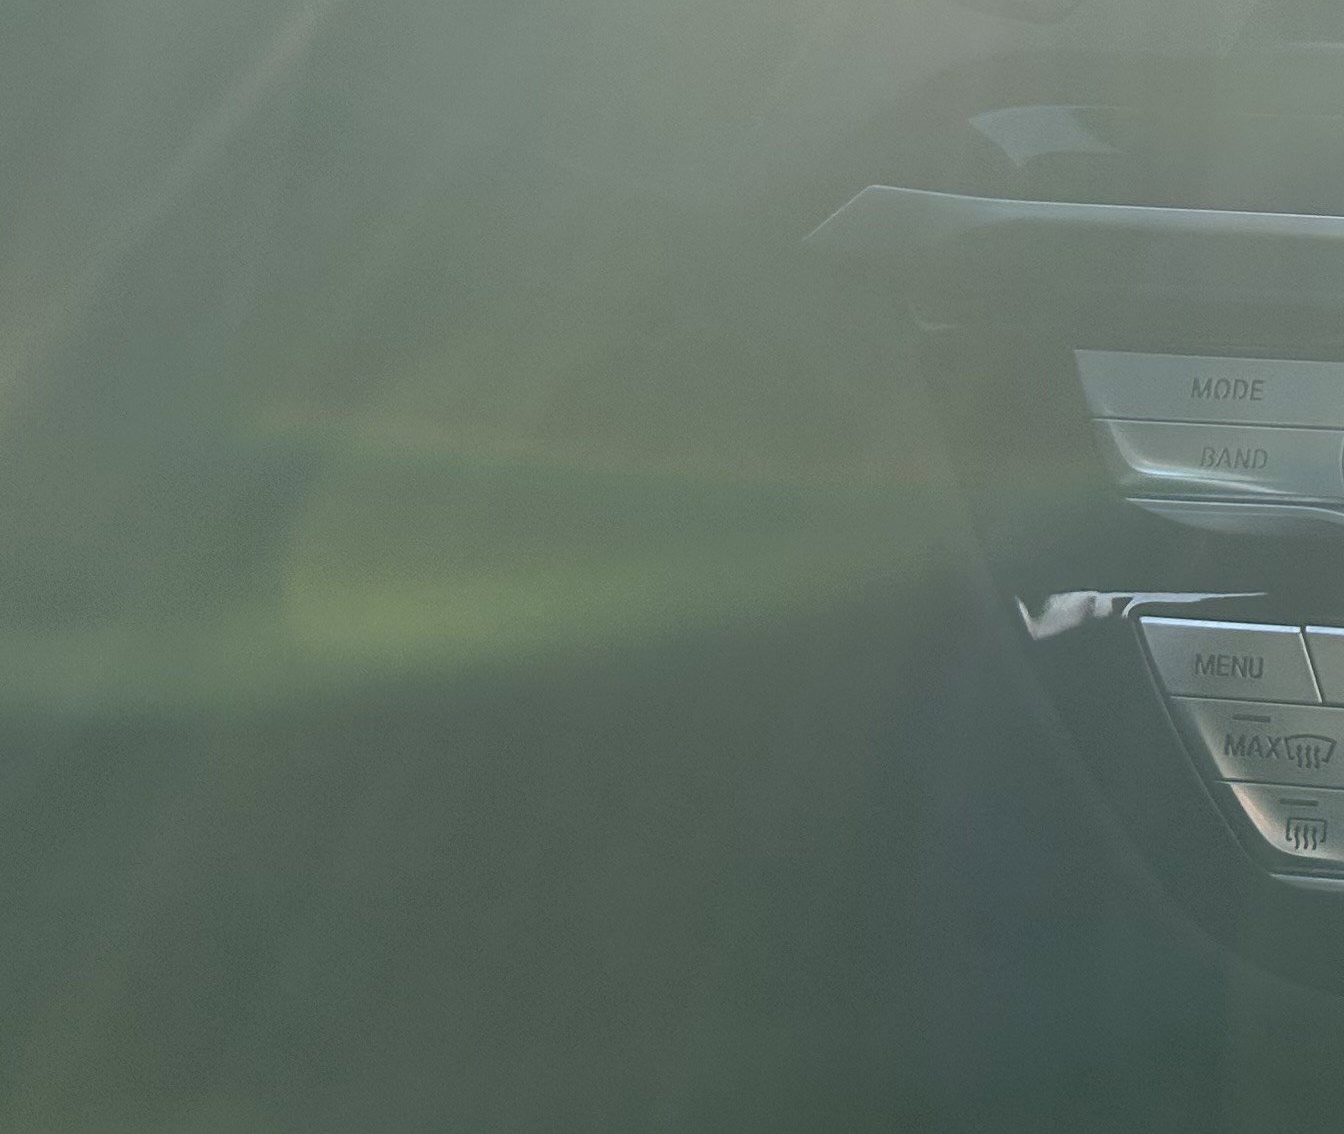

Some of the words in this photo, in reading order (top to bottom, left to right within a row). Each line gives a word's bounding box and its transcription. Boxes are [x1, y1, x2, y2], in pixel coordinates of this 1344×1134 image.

[1190, 377, 1265, 402] MODE
[1200, 446, 1269, 470] BAND
[1194, 653, 1265, 680] MENU
[1224, 732, 1280, 758] MAX
